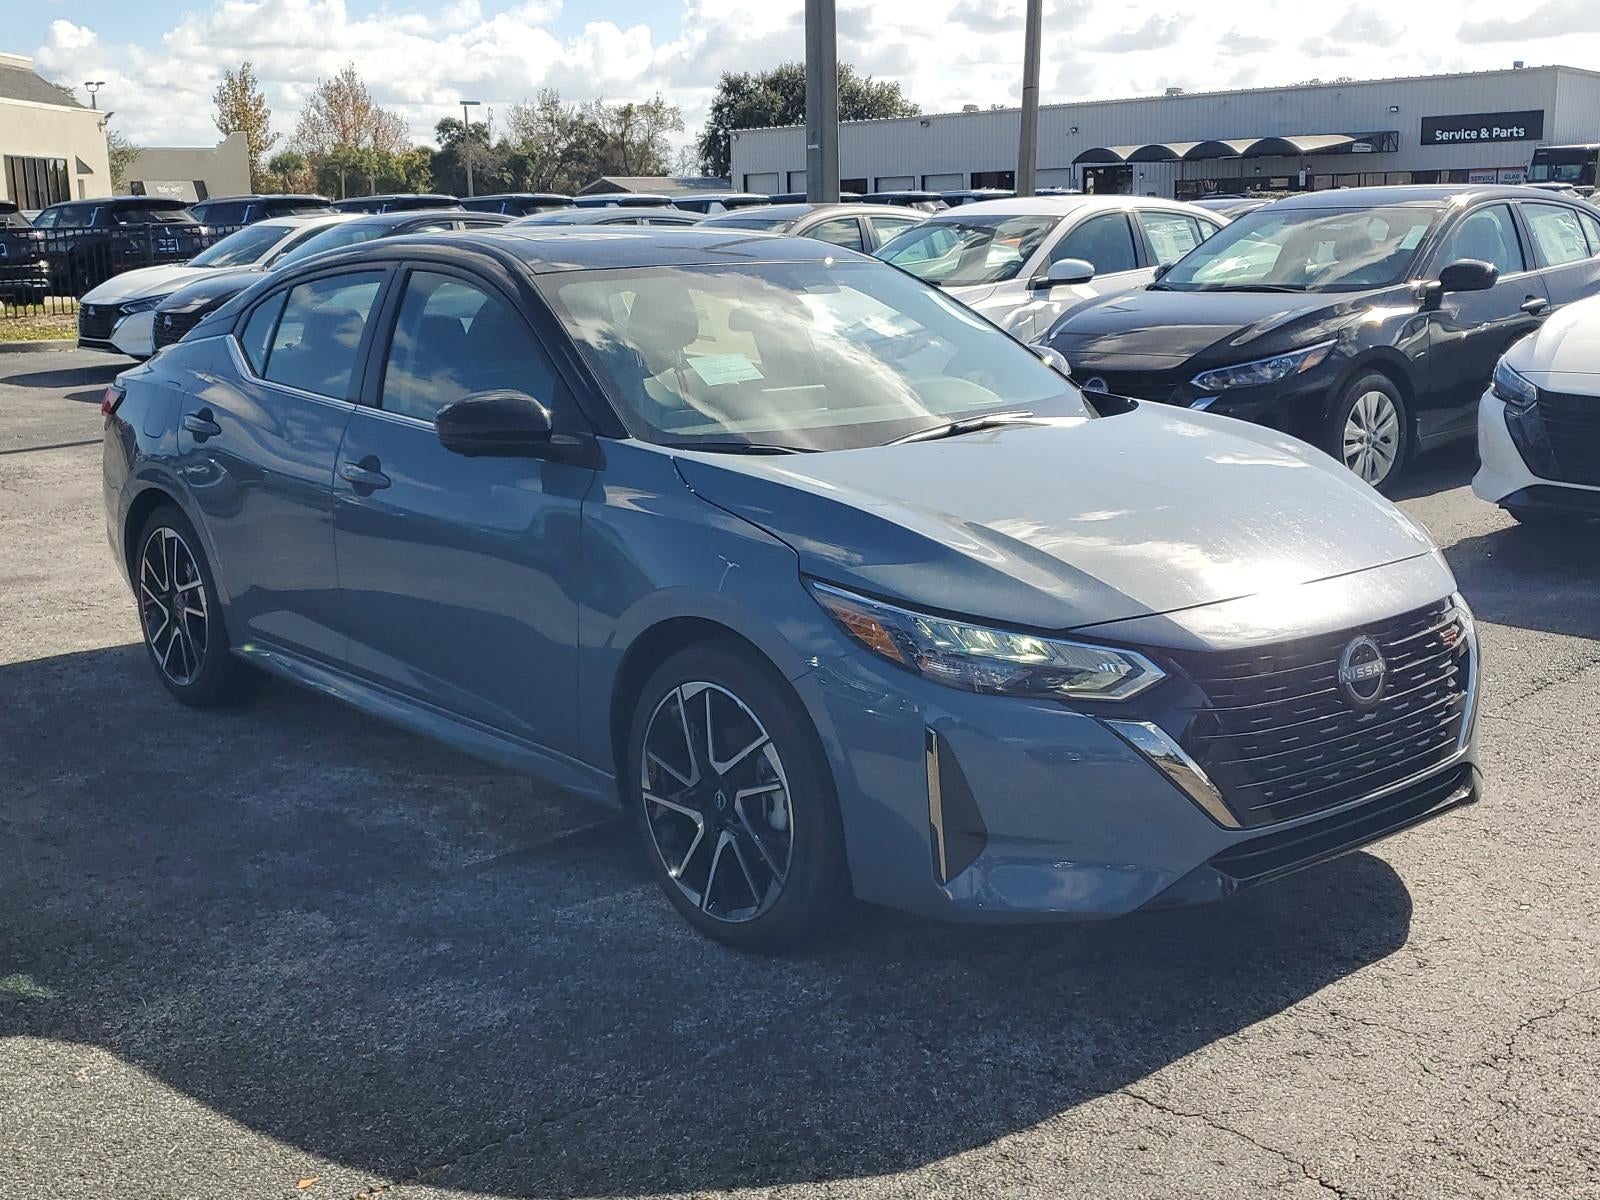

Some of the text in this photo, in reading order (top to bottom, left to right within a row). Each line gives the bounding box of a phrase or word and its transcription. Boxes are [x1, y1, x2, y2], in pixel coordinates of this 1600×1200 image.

[1435, 126, 1525, 140] Service & Parts
[1341, 662, 1385, 681] NISSAN
